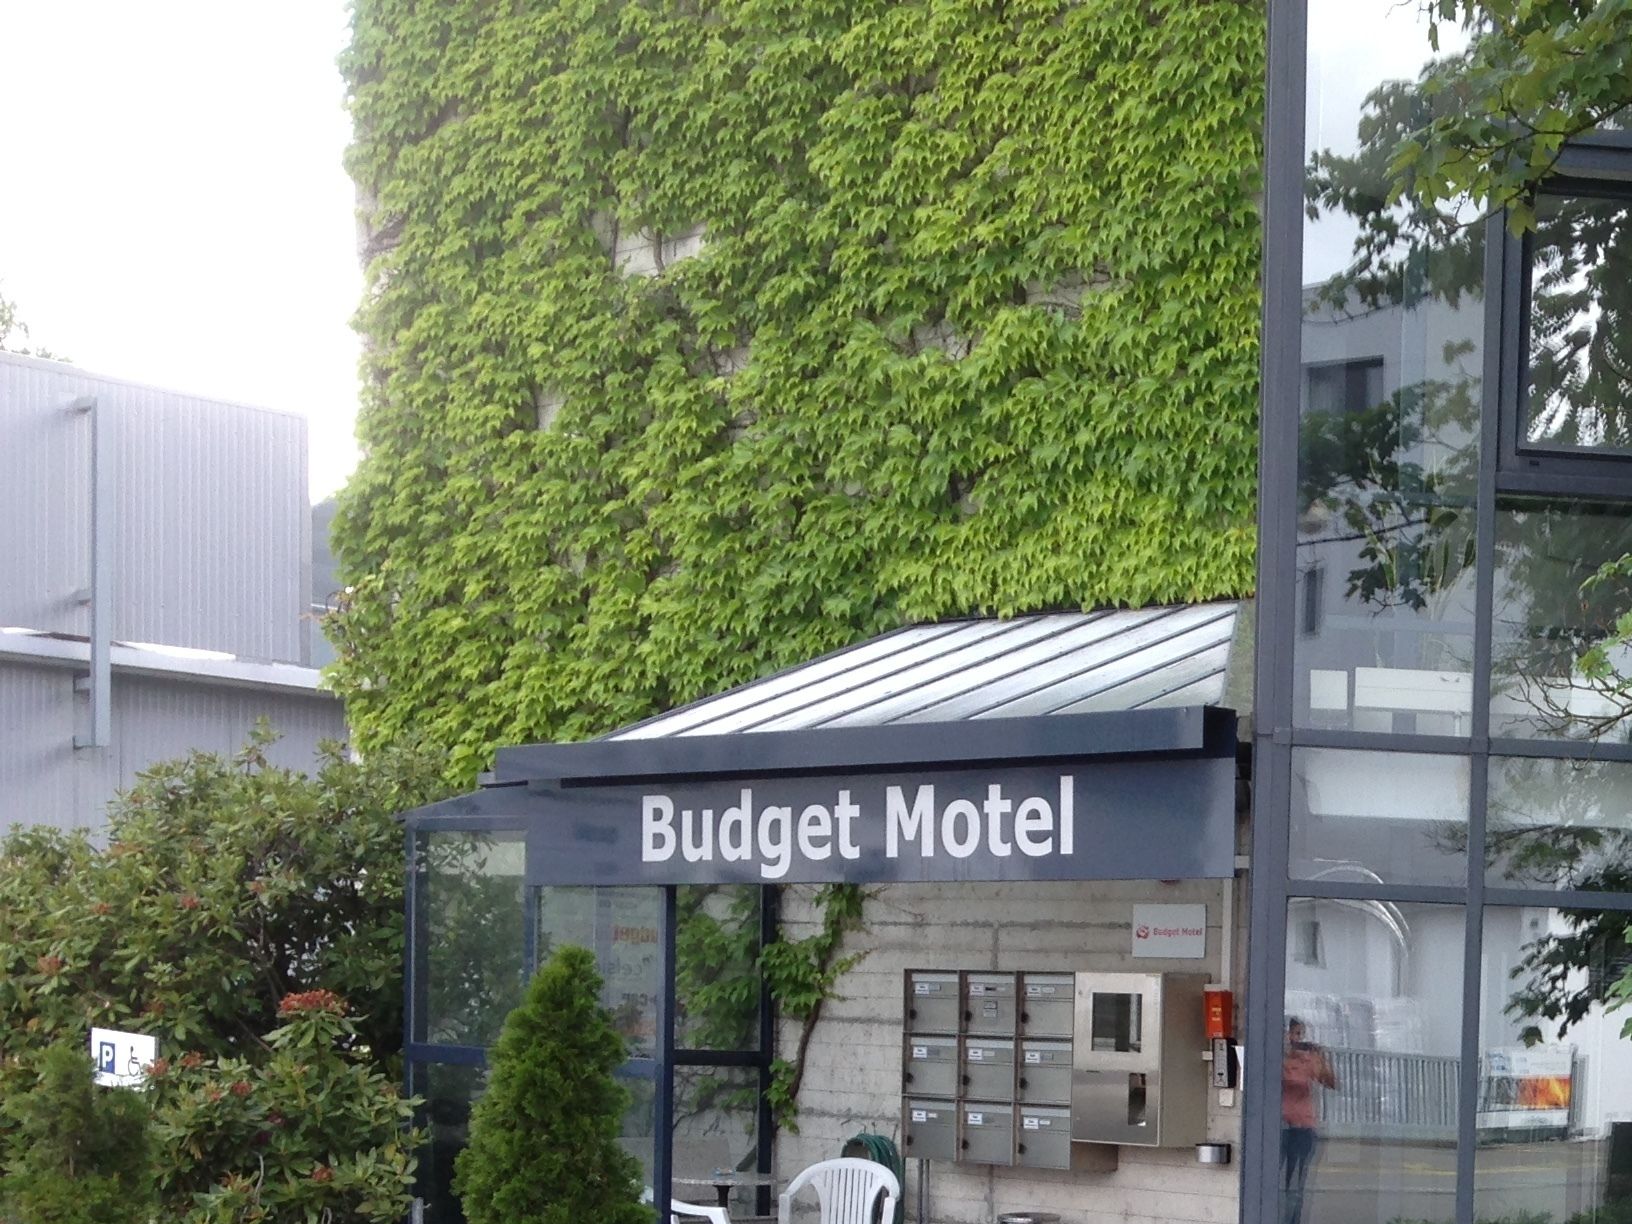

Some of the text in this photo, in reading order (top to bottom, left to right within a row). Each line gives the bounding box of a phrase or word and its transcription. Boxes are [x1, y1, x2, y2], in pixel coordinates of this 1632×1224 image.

[641, 775, 1074, 879] Budget Motel
[102, 1044, 114, 1069] P
